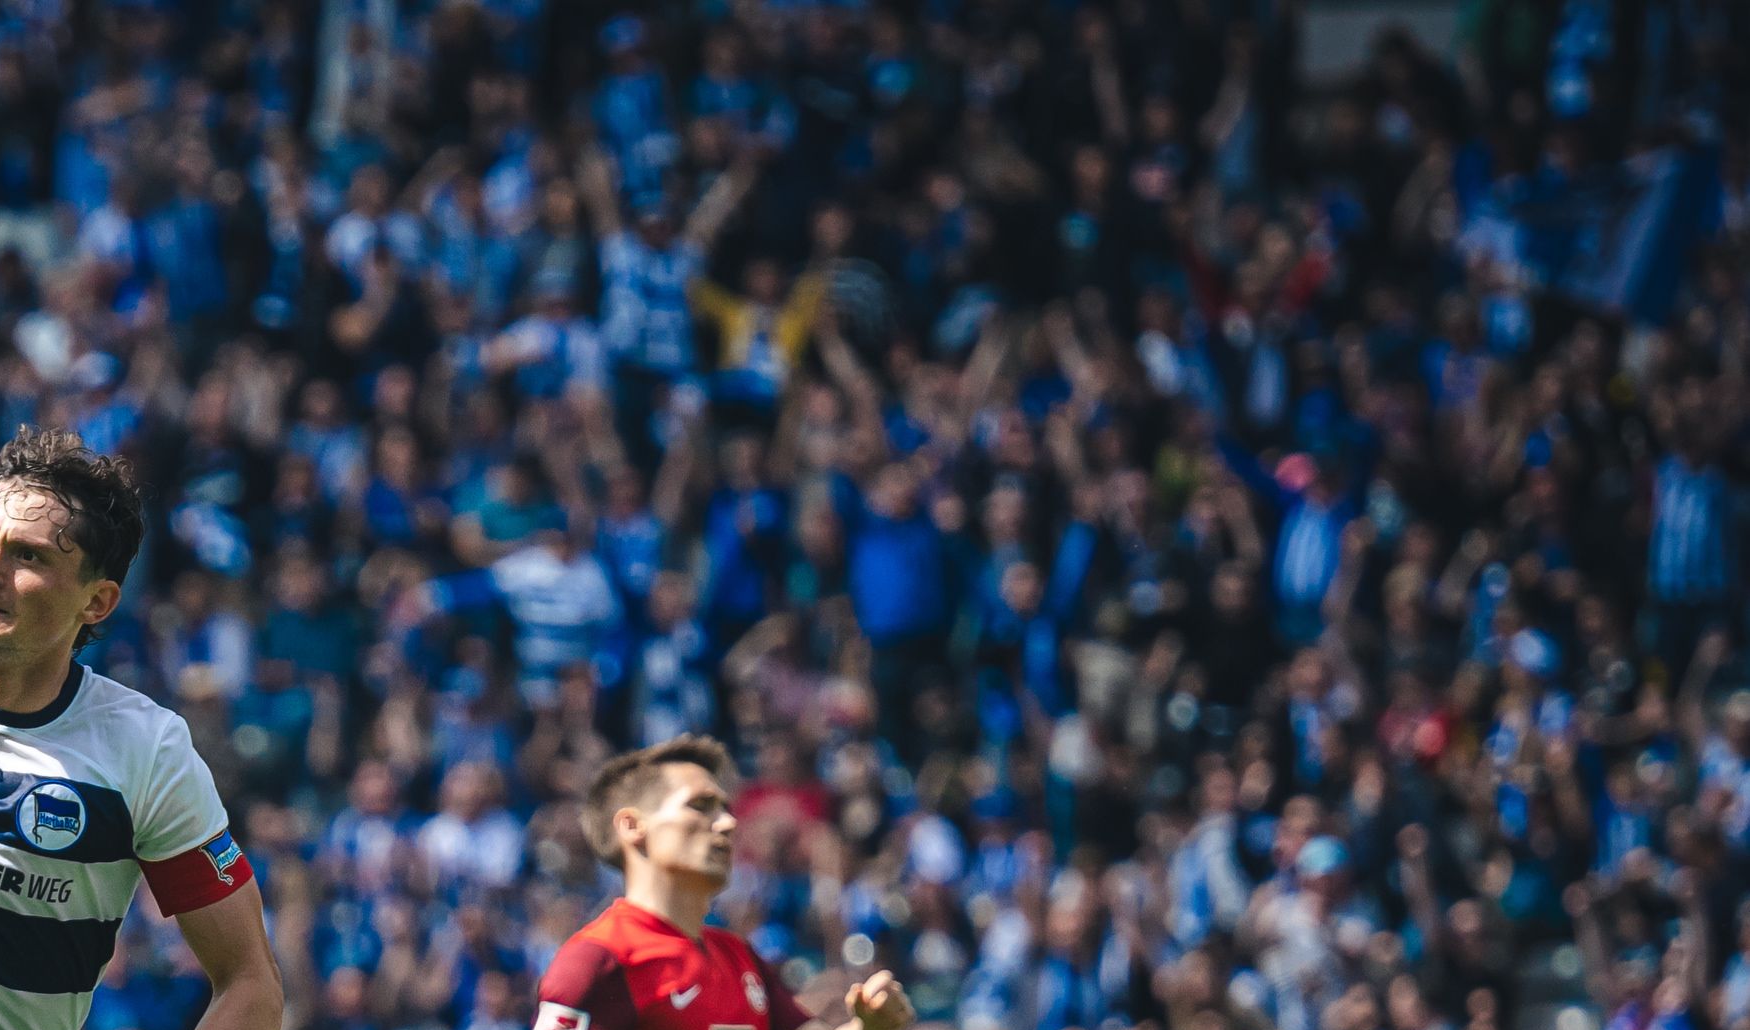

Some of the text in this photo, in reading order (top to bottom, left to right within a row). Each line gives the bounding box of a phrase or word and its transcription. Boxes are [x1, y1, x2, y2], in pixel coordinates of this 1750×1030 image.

[39, 812, 78, 831] Hertha BSC
[27, 873, 74, 903] WEG
